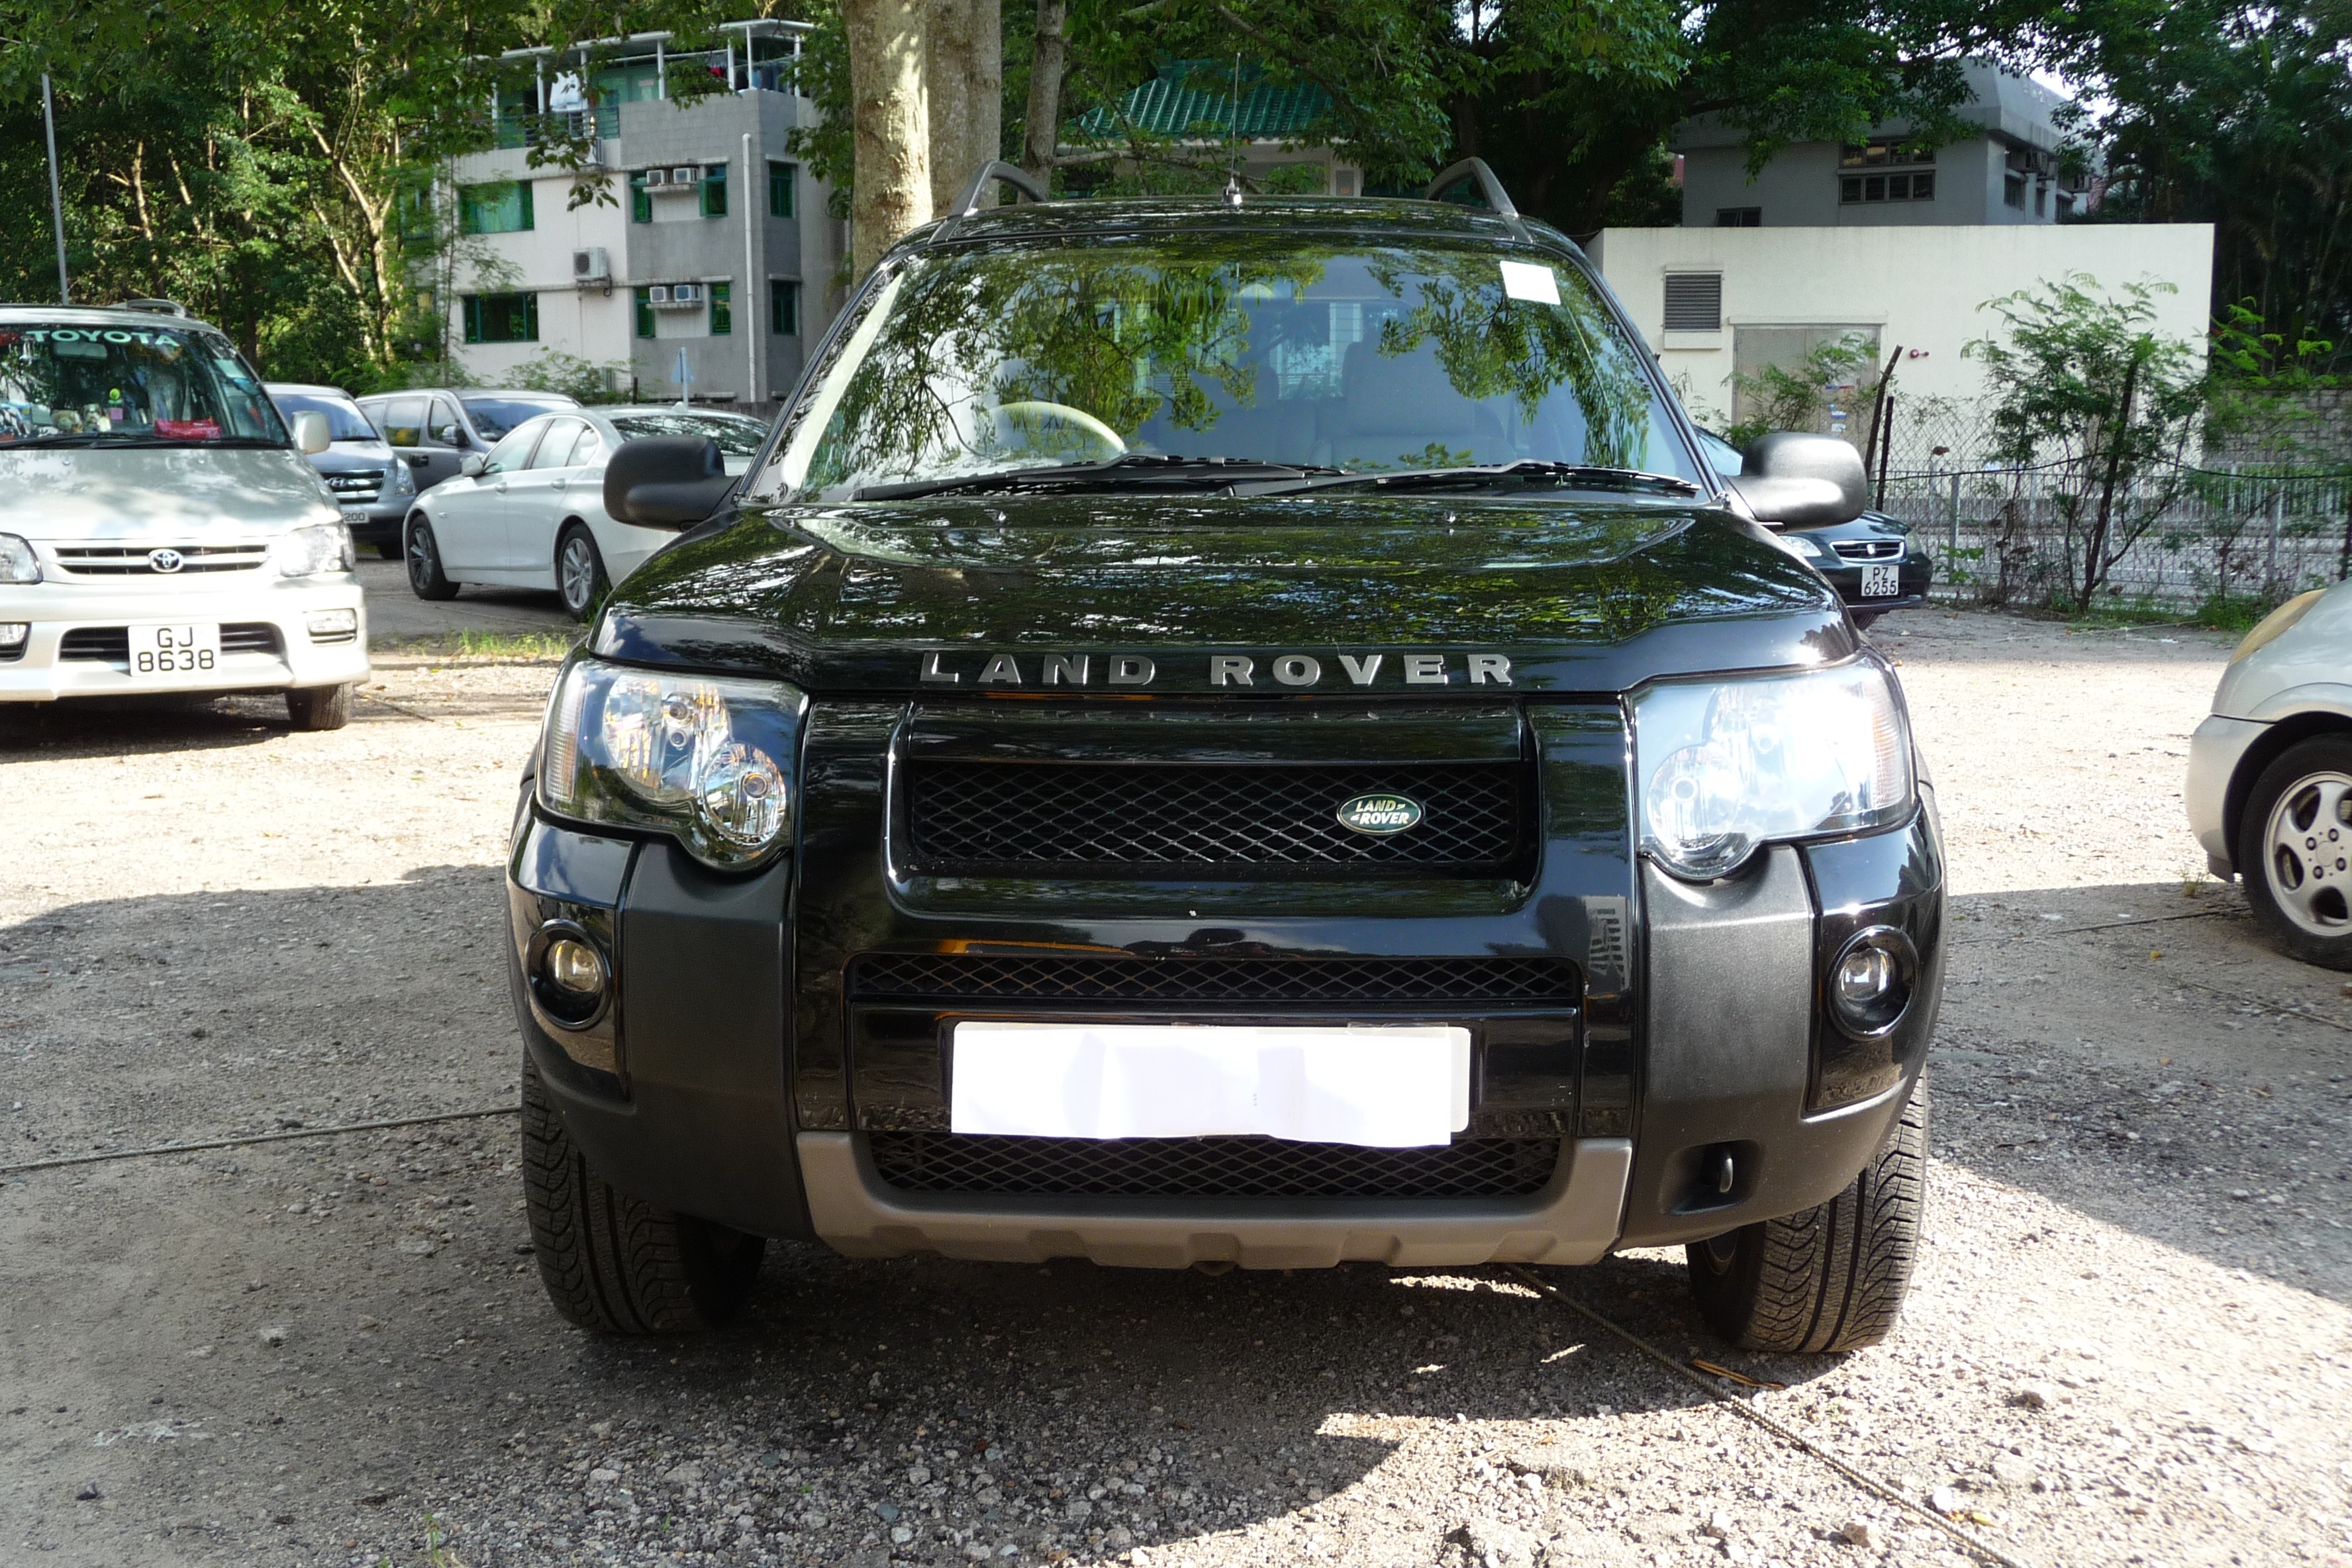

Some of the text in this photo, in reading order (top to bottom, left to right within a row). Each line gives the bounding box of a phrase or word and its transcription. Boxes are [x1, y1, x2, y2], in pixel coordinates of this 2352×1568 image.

[26, 330, 180, 348] TOYOTA
[344, 512, 366, 522] 200
[1873, 567, 1888, 581] PZ
[1864, 580, 1896, 595] 6255
[157, 626, 193, 648] GJ
[138, 649, 214, 672] 8638
[920, 653, 1512, 686] LAND ROVER
[1355, 800, 1396, 812] LAND
[1359, 812, 1410, 824] ROVER
